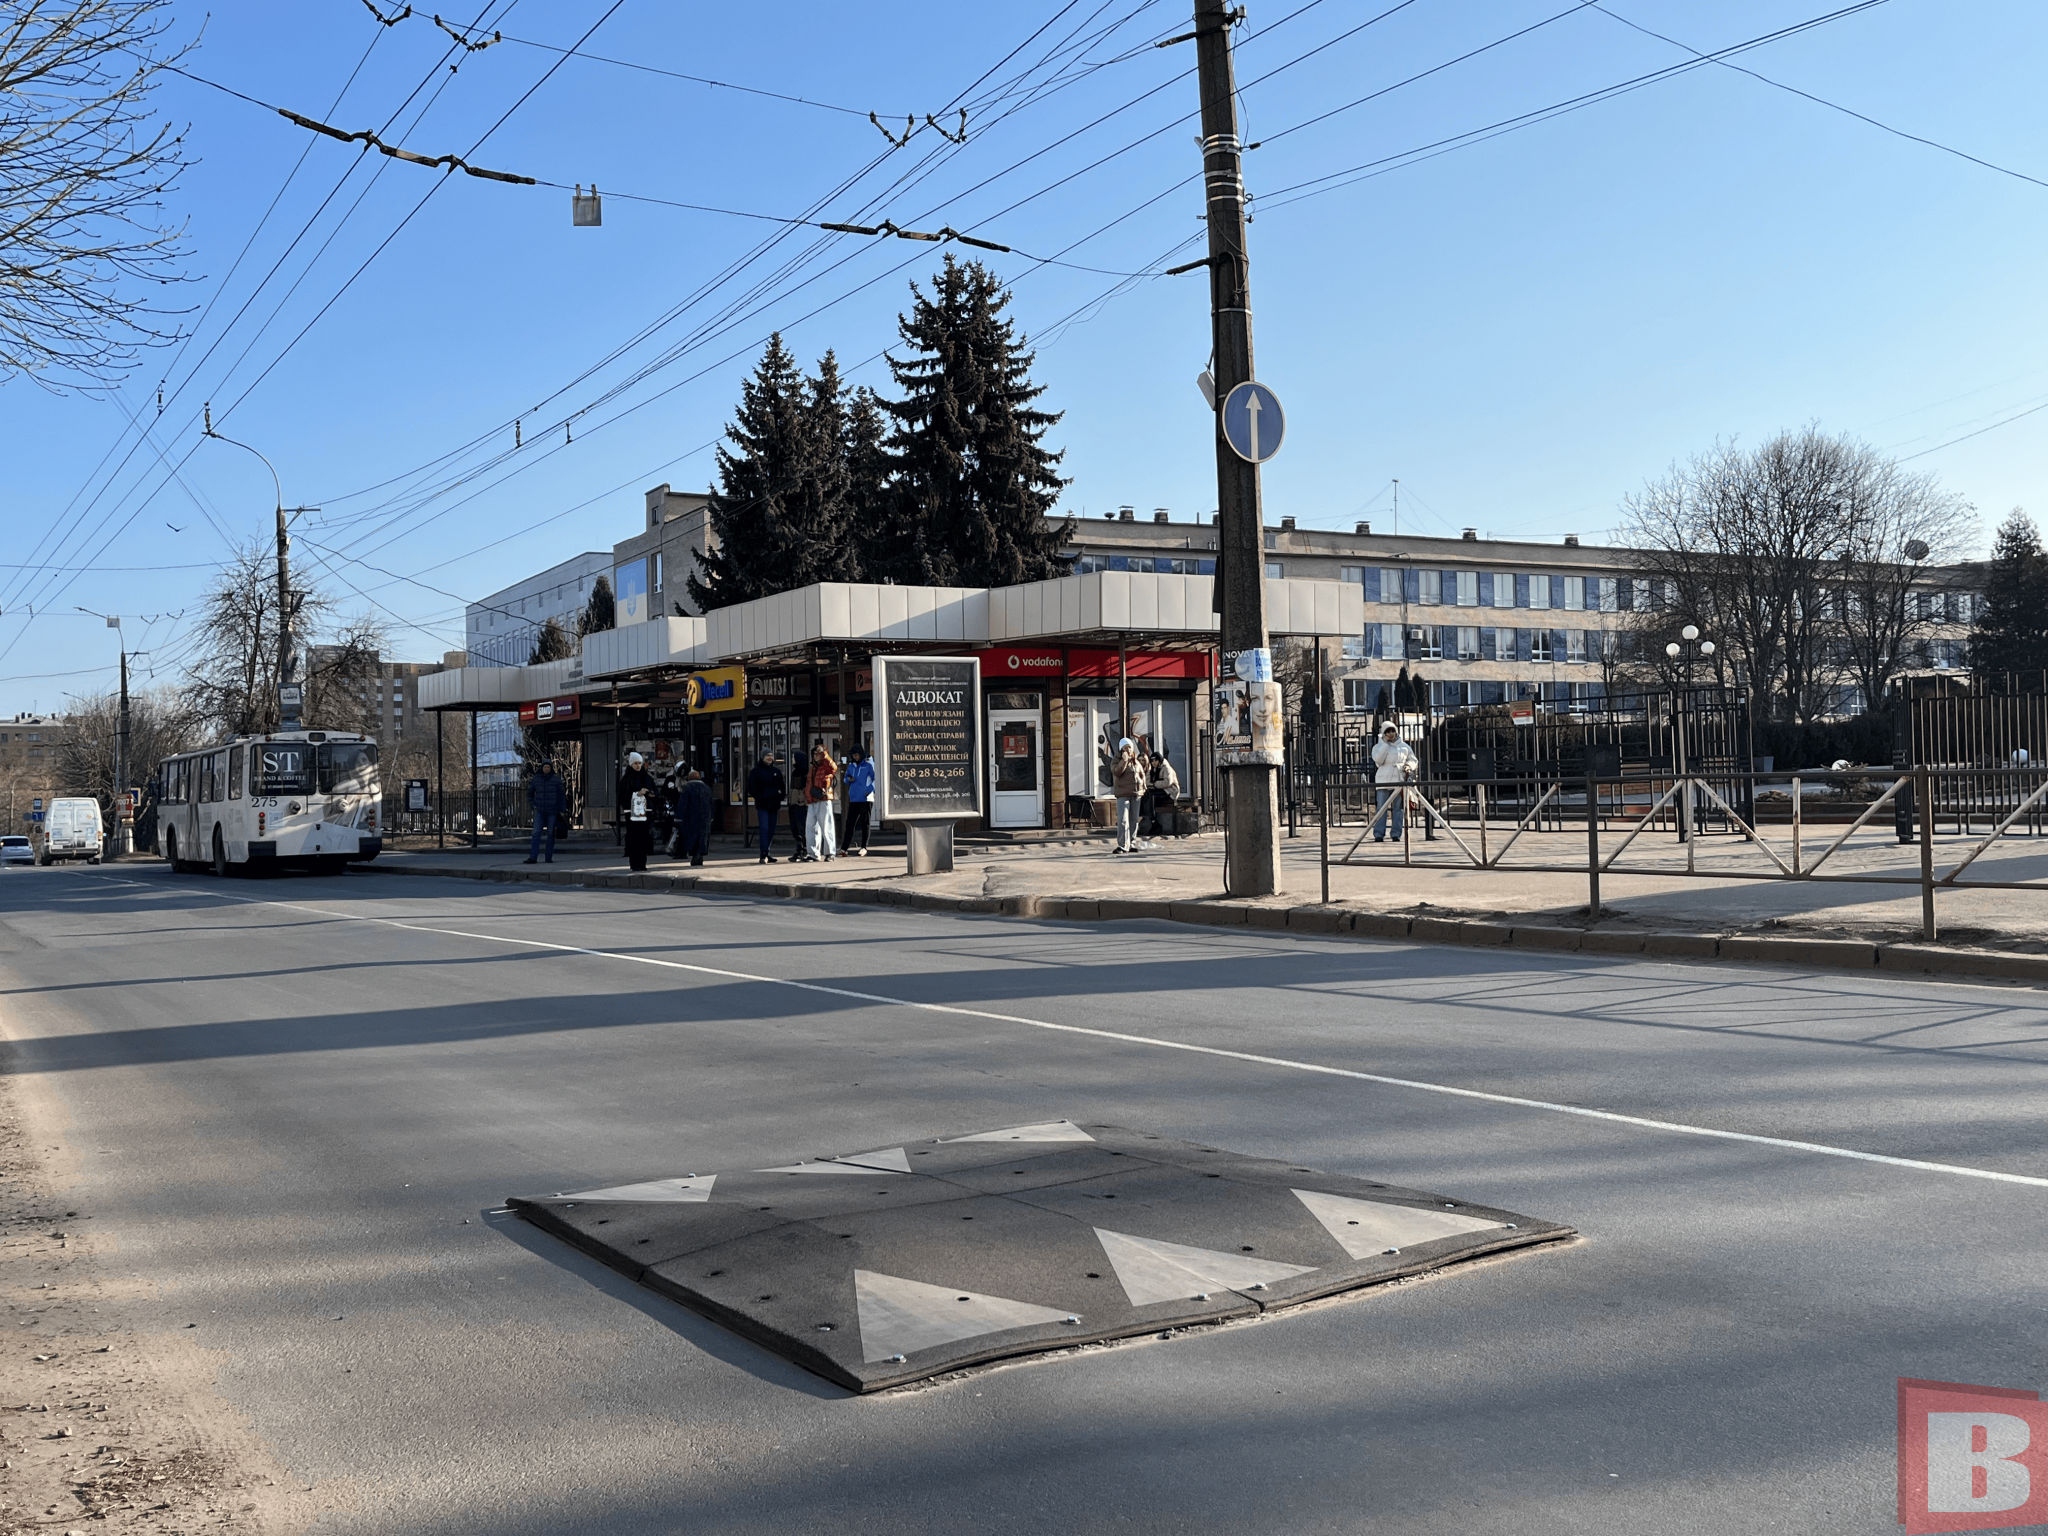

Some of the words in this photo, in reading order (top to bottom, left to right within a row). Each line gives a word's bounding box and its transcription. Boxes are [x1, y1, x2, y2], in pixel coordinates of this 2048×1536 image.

[703, 680, 731, 699] lifecell
[896, 690, 963, 706] АДВОКАТ
[895, 710, 924, 718] СПРАВИ
[925, 710, 965, 718] ПОВ'ЯЗАНІ
[905, 719, 961, 727] МОБІЛІЗАЦІЄЮ
[895, 731, 935, 739] ВІЙСЬКОВІ
[904, 744, 957, 752] ПЕРЕРАХУНОК
[892, 753, 940, 761] ВІЙСЬКОВИХ
[941, 752, 969, 760] ПЕНСІЙ
[263, 751, 299, 773] ST
[897, 768, 917, 779] 098
[918, 768, 931, 778] 28
[933, 767, 945, 777] 82
[947, 767, 965, 777] 266
[251, 796, 278, 807] 275
